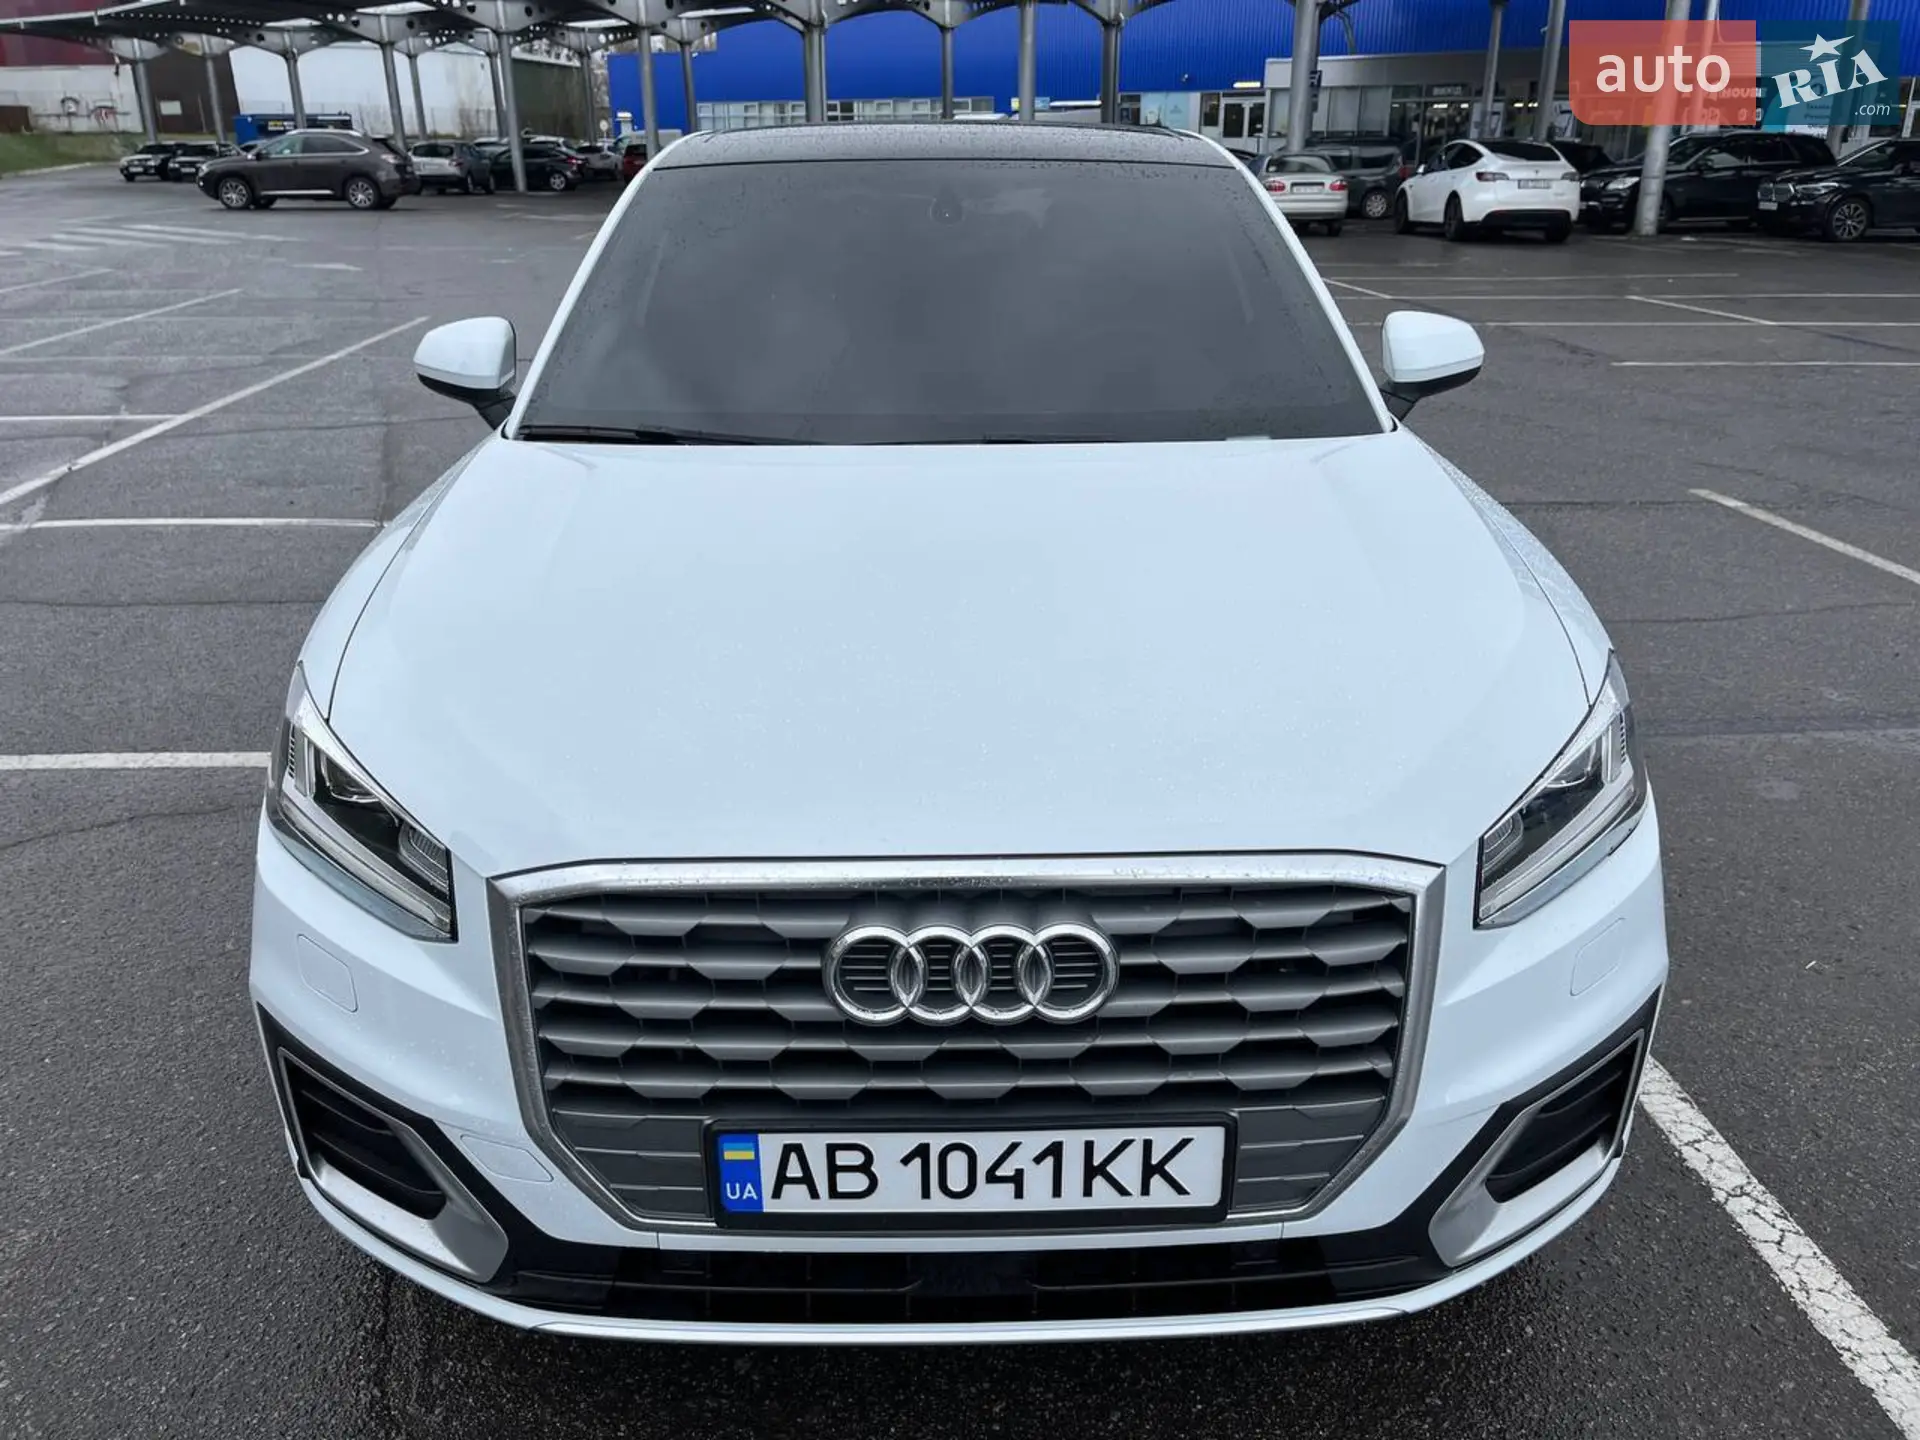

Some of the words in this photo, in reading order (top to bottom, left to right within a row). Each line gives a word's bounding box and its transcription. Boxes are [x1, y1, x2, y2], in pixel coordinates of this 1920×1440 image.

[771, 1142, 879, 1200] AB
[899, 1140, 1065, 1200] 1041
[1082, 1137, 1195, 1198] KK
[725, 1182, 758, 1201] UA
